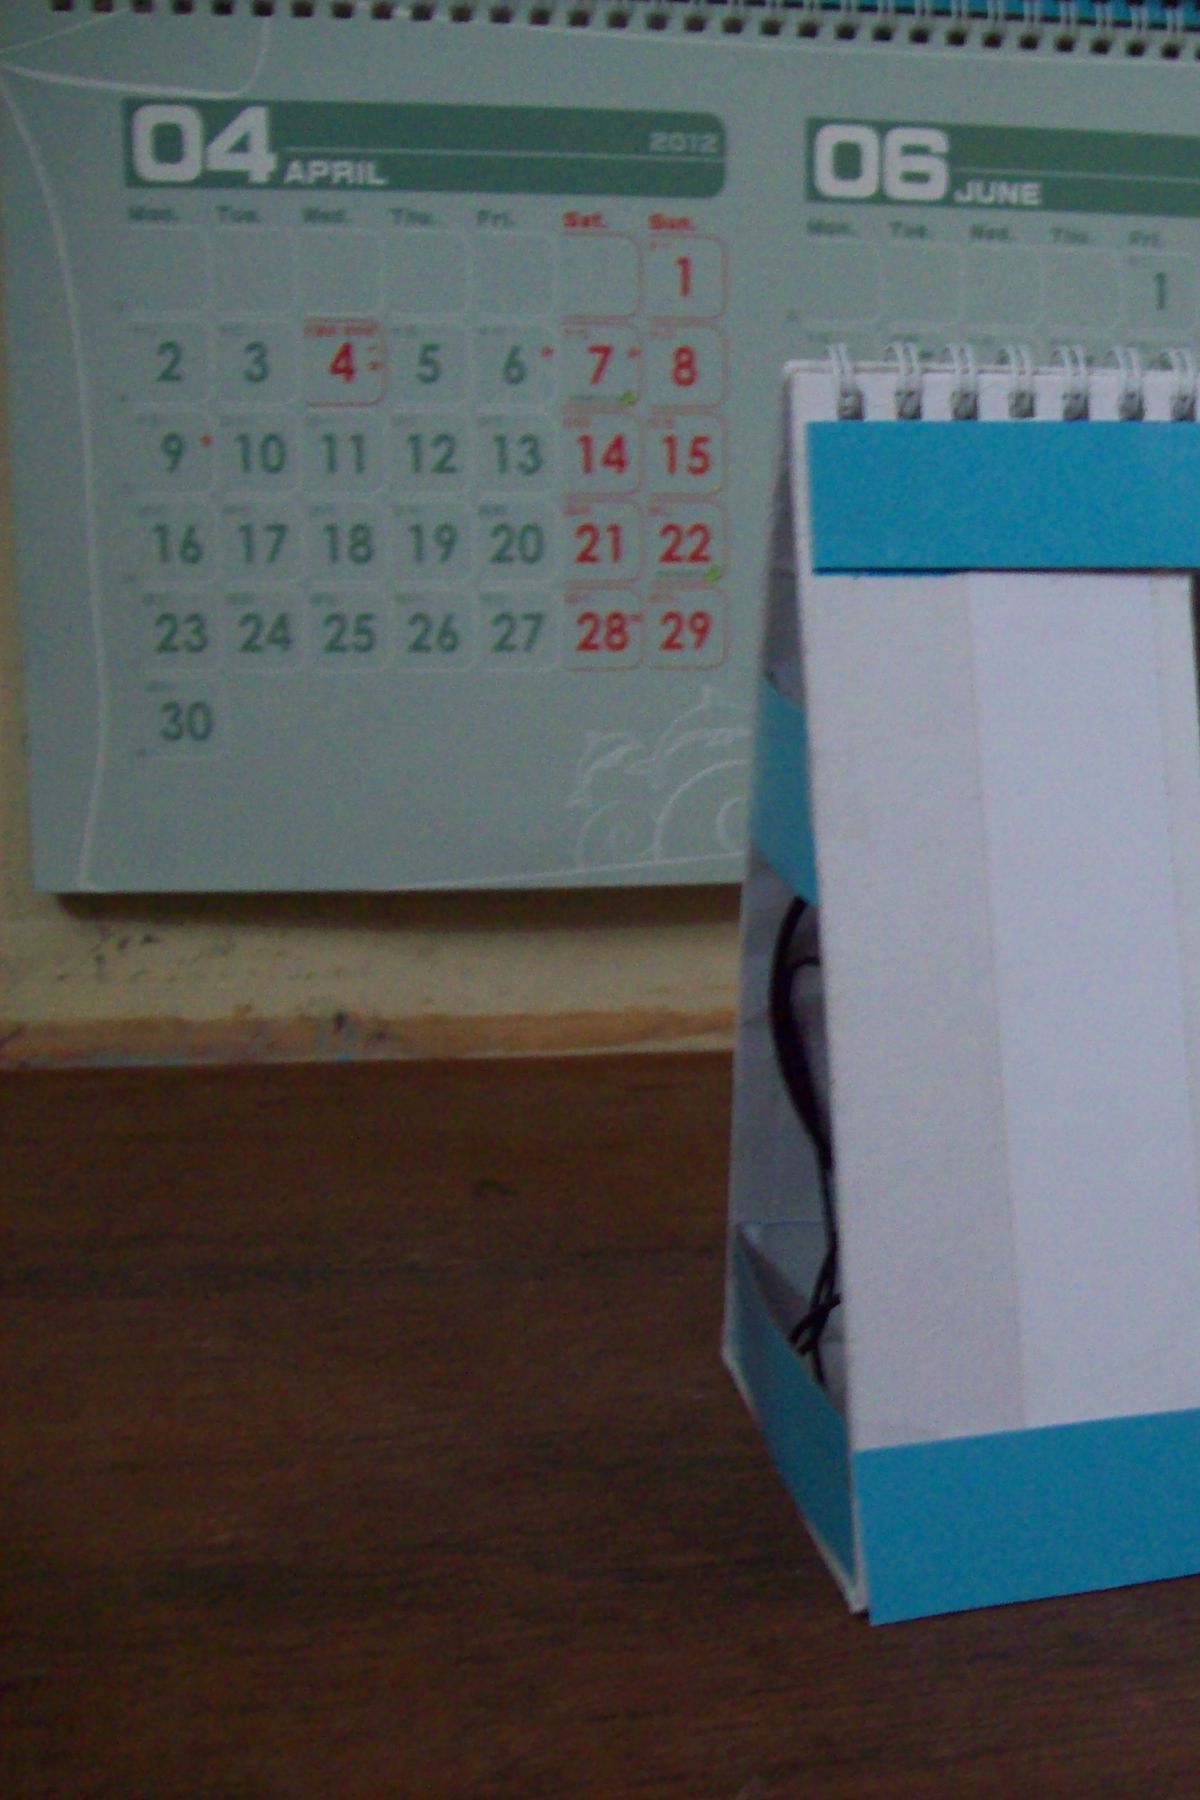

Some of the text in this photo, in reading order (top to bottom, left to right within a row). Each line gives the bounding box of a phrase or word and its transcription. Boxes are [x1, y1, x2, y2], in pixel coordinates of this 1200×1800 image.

[131, 105, 388, 186] 04 APRIL
[813, 124, 1043, 205] 06 JUNE
[675, 258, 691, 297] 1
[1152, 272, 1168, 310] 1
[156, 341, 697, 386] 2 3 4 5 6 7 8
[161, 433, 711, 475] 9 10 11 12 13 14 15
[154, 524, 712, 565] 16 17 18 19 20 21 22
[154, 612, 711, 654] 23 24 25 26 27 28 29
[160, 701, 212, 741] 30
